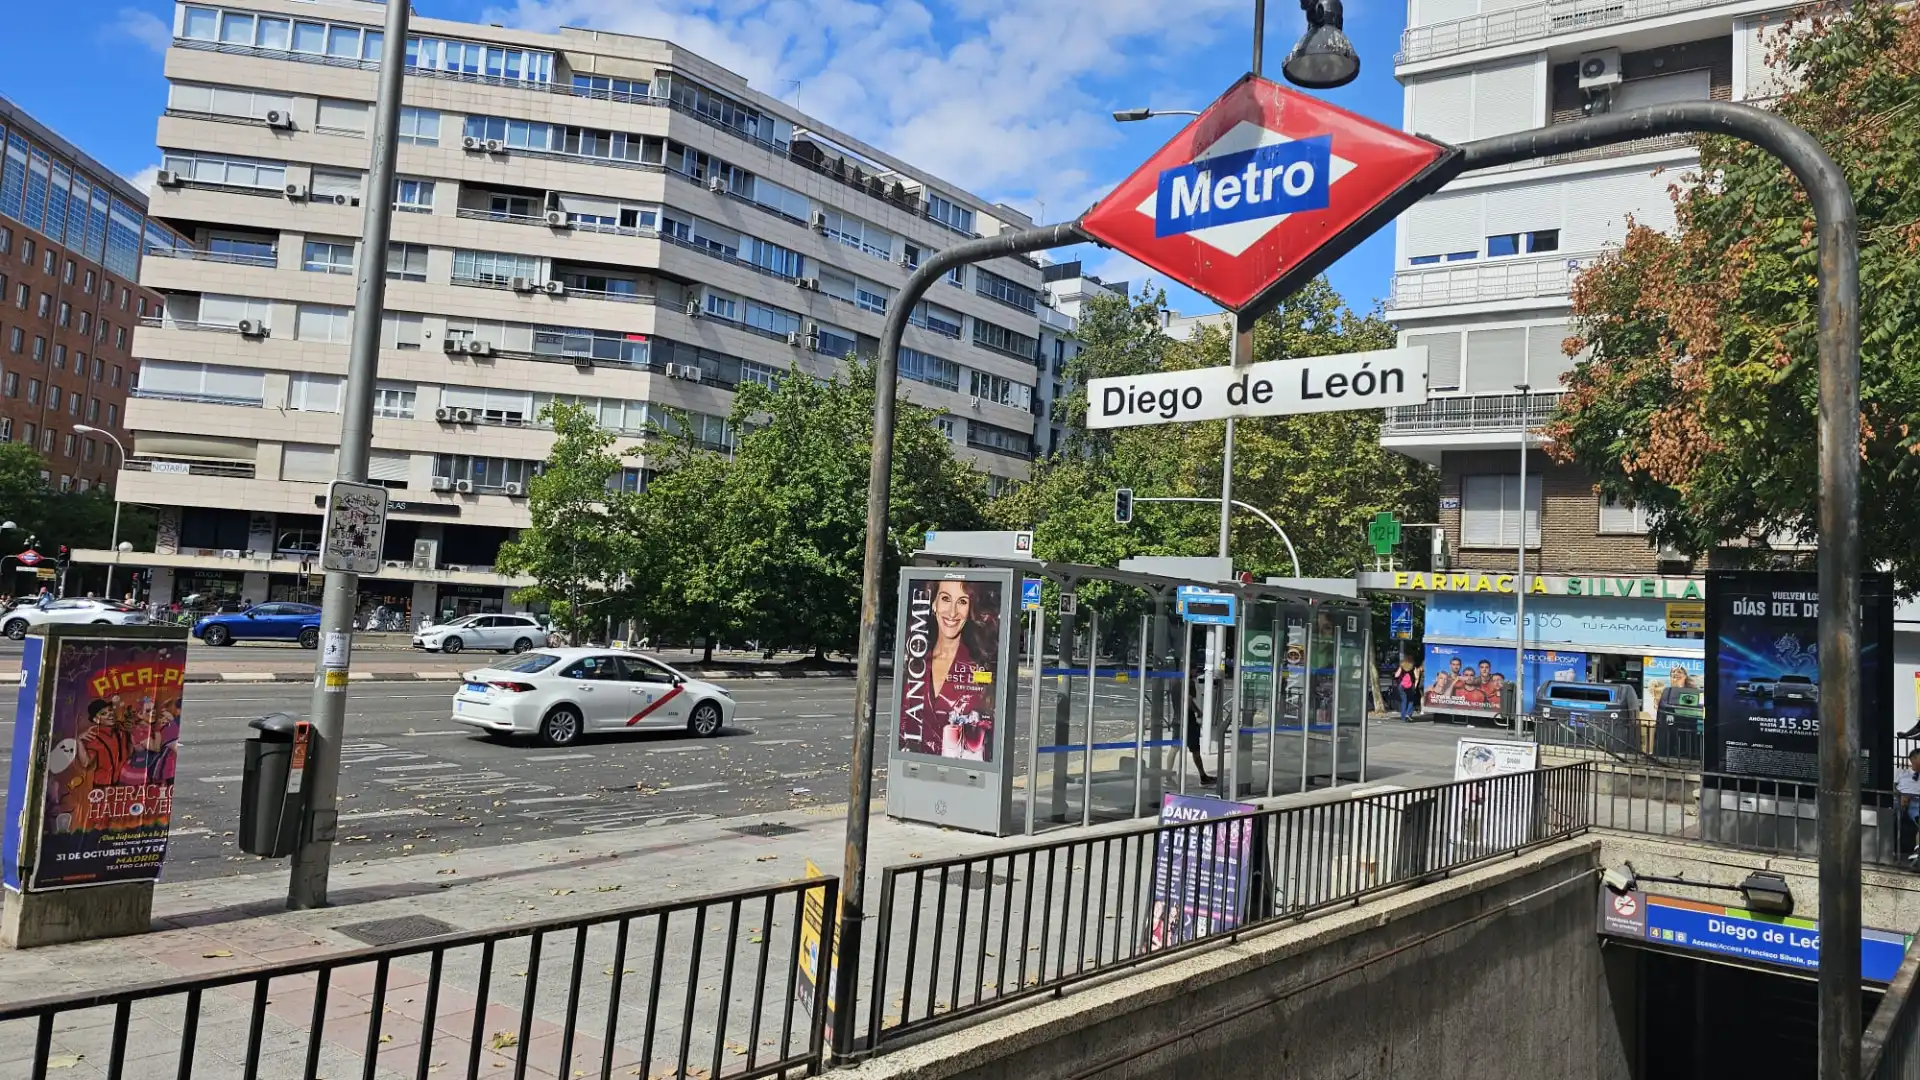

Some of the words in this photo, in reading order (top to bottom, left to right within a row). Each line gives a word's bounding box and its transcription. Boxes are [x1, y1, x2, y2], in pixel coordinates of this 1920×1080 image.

[1170, 160, 1315, 220] Metro
[1102, 385, 1202, 419] Diego
[1226, 373, 1273, 405] de
[1302, 361, 1405, 400] León
[1373, 527, 1396, 541] 12H
[1394, 572, 1549, 594] FARMACA
[1567, 576, 1704, 599] SILVELA
[1772, 591, 1806, 600] VUELVEN
[1733, 597, 1766, 616] DÍAS
[1772, 602, 1798, 617] DEL
[1537, 612, 1562, 628] 56
[1583, 622, 1597, 630] TU
[903, 587, 932, 743] LANCÔME
[954, 663, 966, 673] La
[946, 674, 964, 683] est
[1162, 805, 1208, 820] DANZA
[56, 853, 66, 861] 31
[68, 852, 80, 860] DE
[82, 848, 129, 859] OCTUBRE,
[145, 845, 151, 853] 7
[153, 844, 165, 852] DE
[116, 854, 159, 863] MADRID
[1708, 919, 1758, 940] Diego
[1762, 929, 1785, 944] de
[1790, 932, 1820, 950] Leó
[1744, 947, 1778, 959] Francisco
